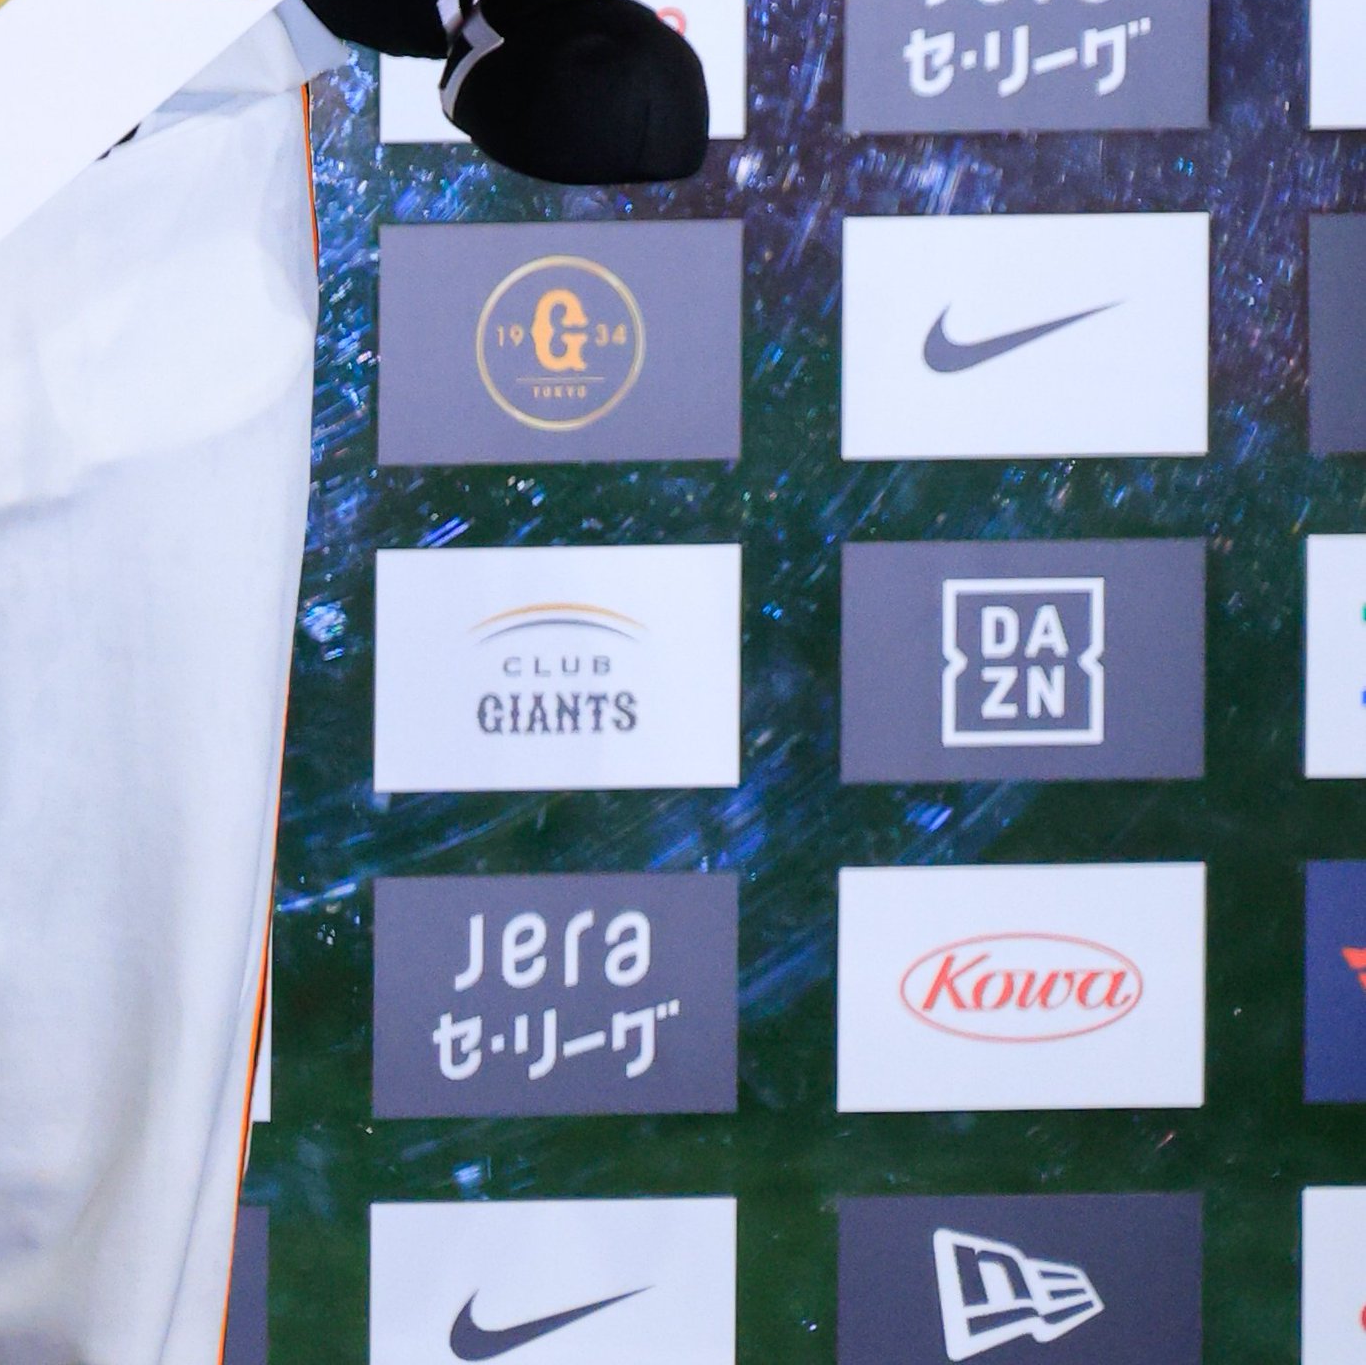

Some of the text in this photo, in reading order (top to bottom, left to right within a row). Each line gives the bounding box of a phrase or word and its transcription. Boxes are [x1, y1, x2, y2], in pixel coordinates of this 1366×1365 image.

[903, 18, 1150, 96] セ・リーグ
[497, 290, 626, 371] 19 G 34
[982, 605, 1068, 658] DA
[503, 656, 610, 676] CLUB
[982, 666, 1064, 718] ZN
[477, 692, 636, 734] GIANTS
[923, 953, 1134, 1014] Kowa
[433, 1000, 679, 1080] セ・リーグ
